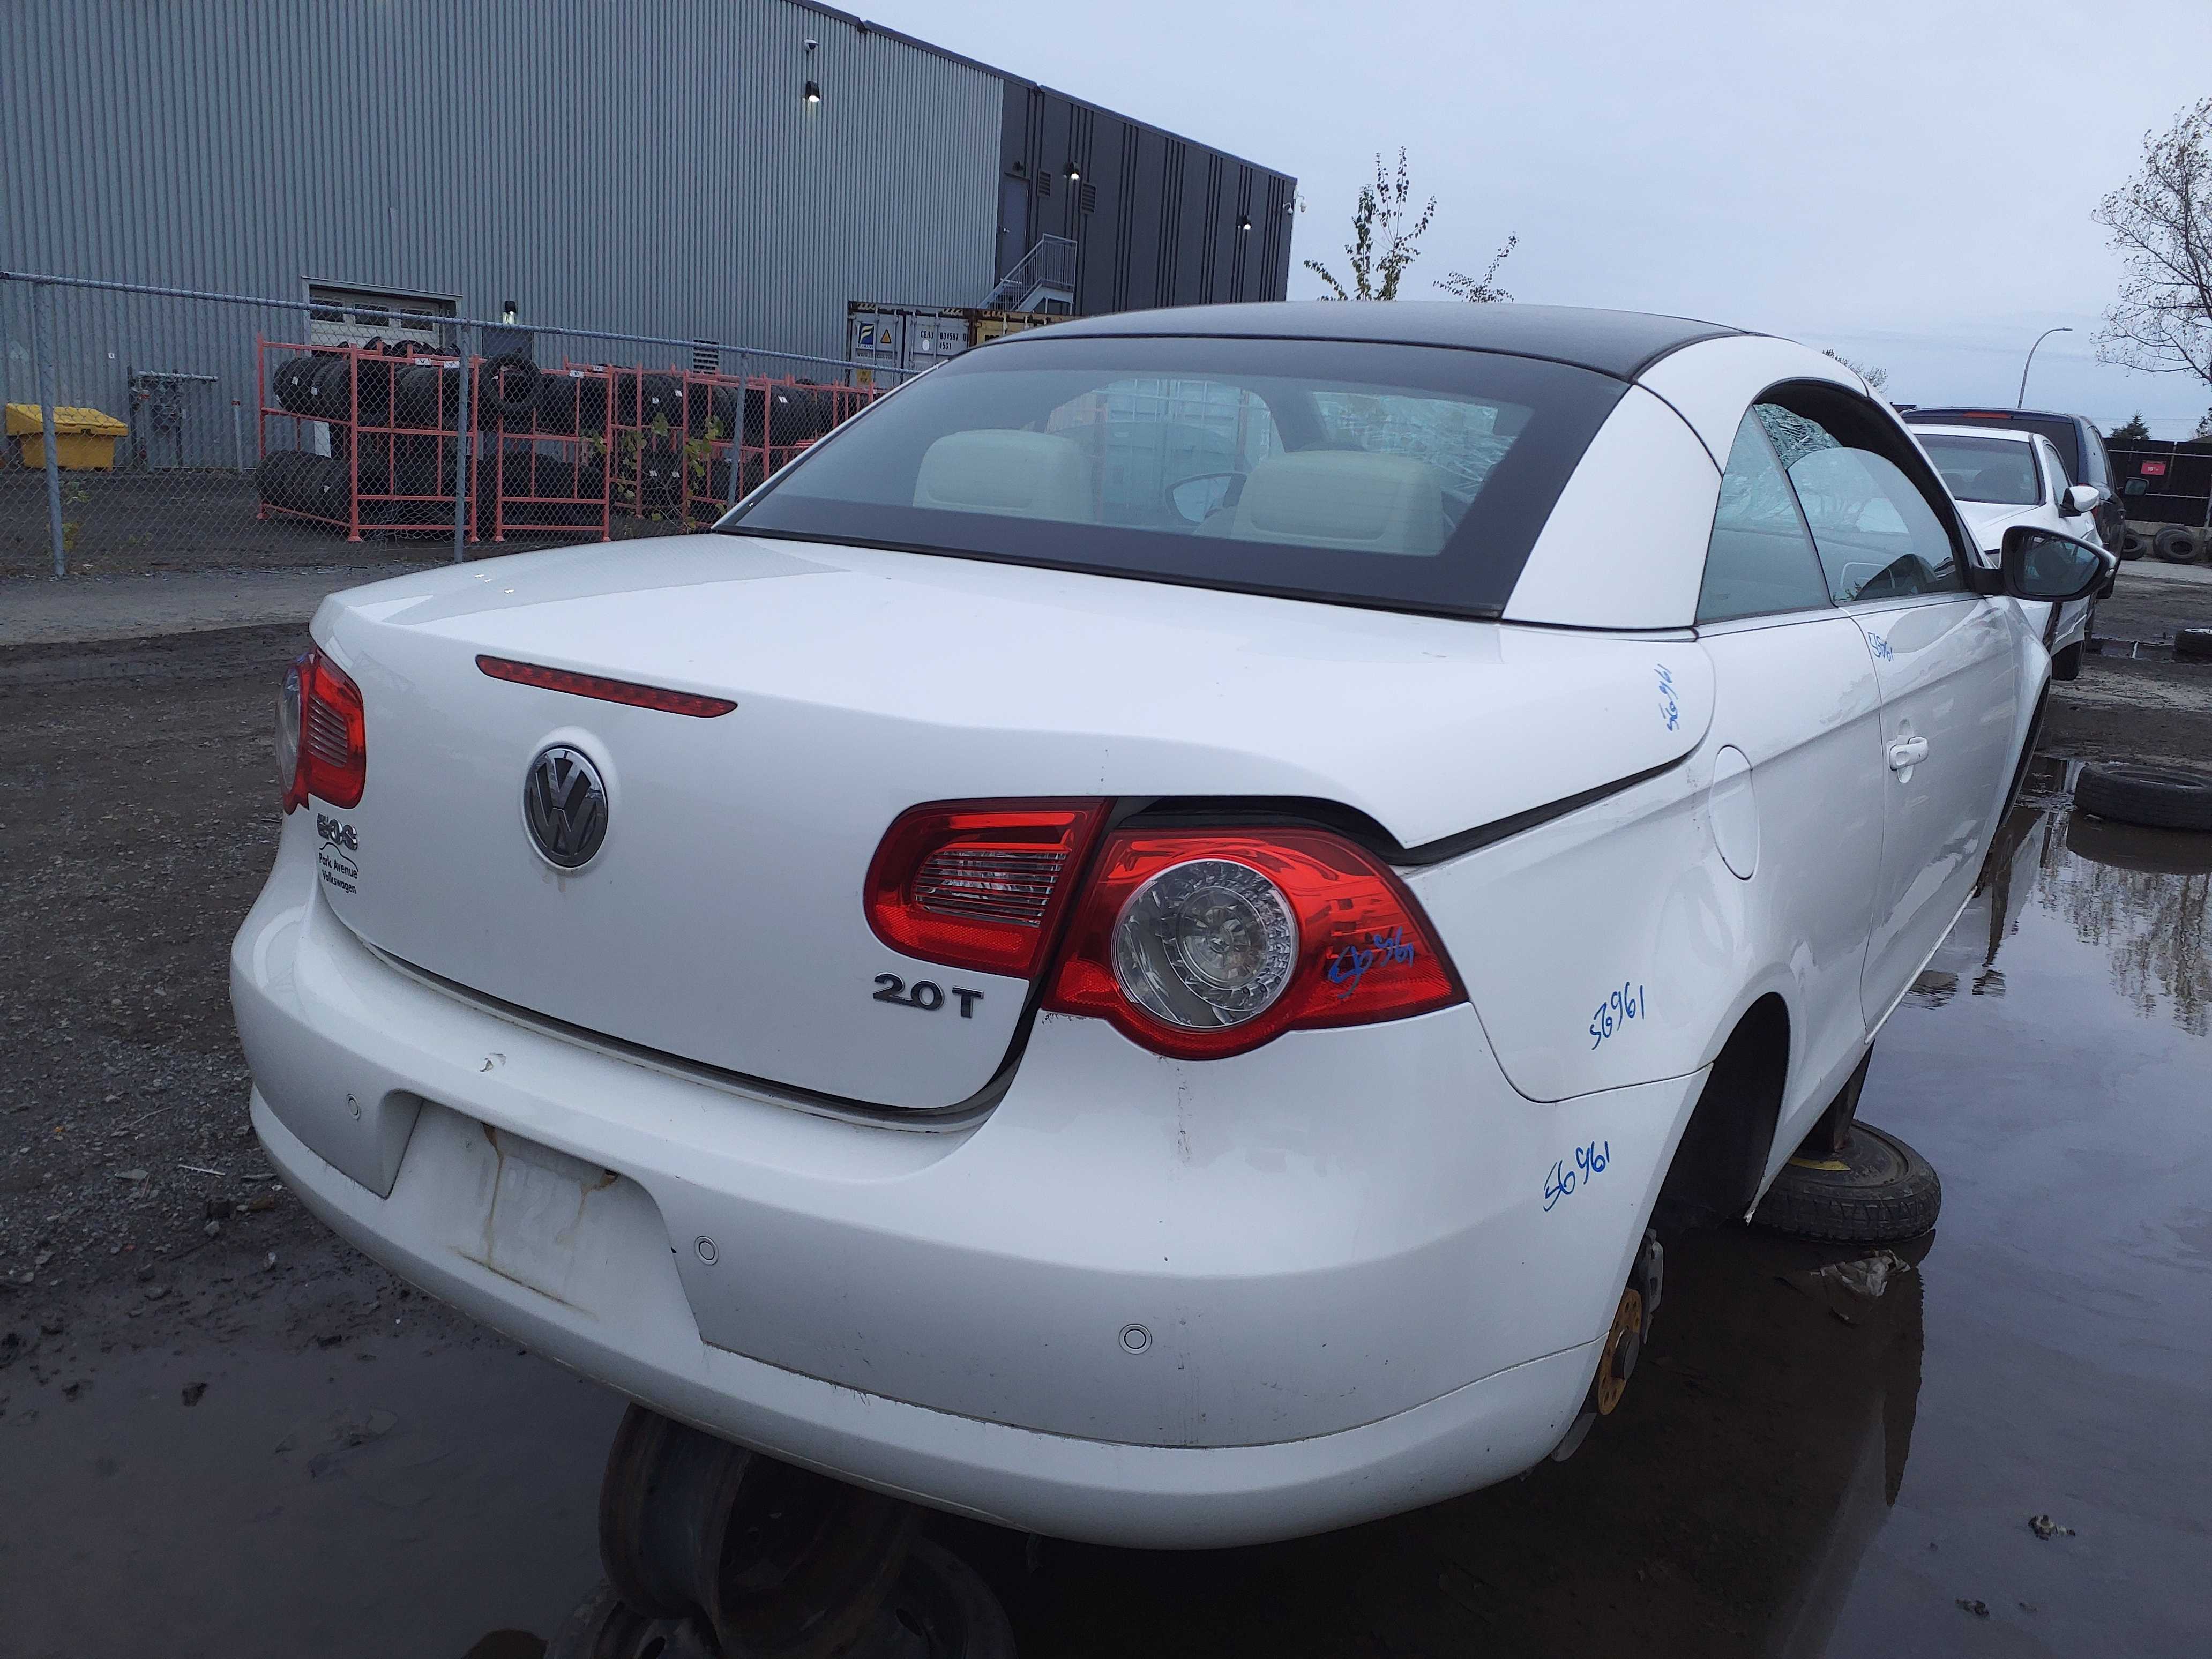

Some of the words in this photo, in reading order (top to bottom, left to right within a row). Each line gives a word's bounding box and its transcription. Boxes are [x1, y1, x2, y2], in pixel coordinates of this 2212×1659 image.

[319, 852, 332, 869] Park
[333, 858, 358, 879] Avenue
[322, 869, 357, 894] Volkswagen
[952, 985, 984, 1019] T
[1589, 981, 1645, 1050] 56961
